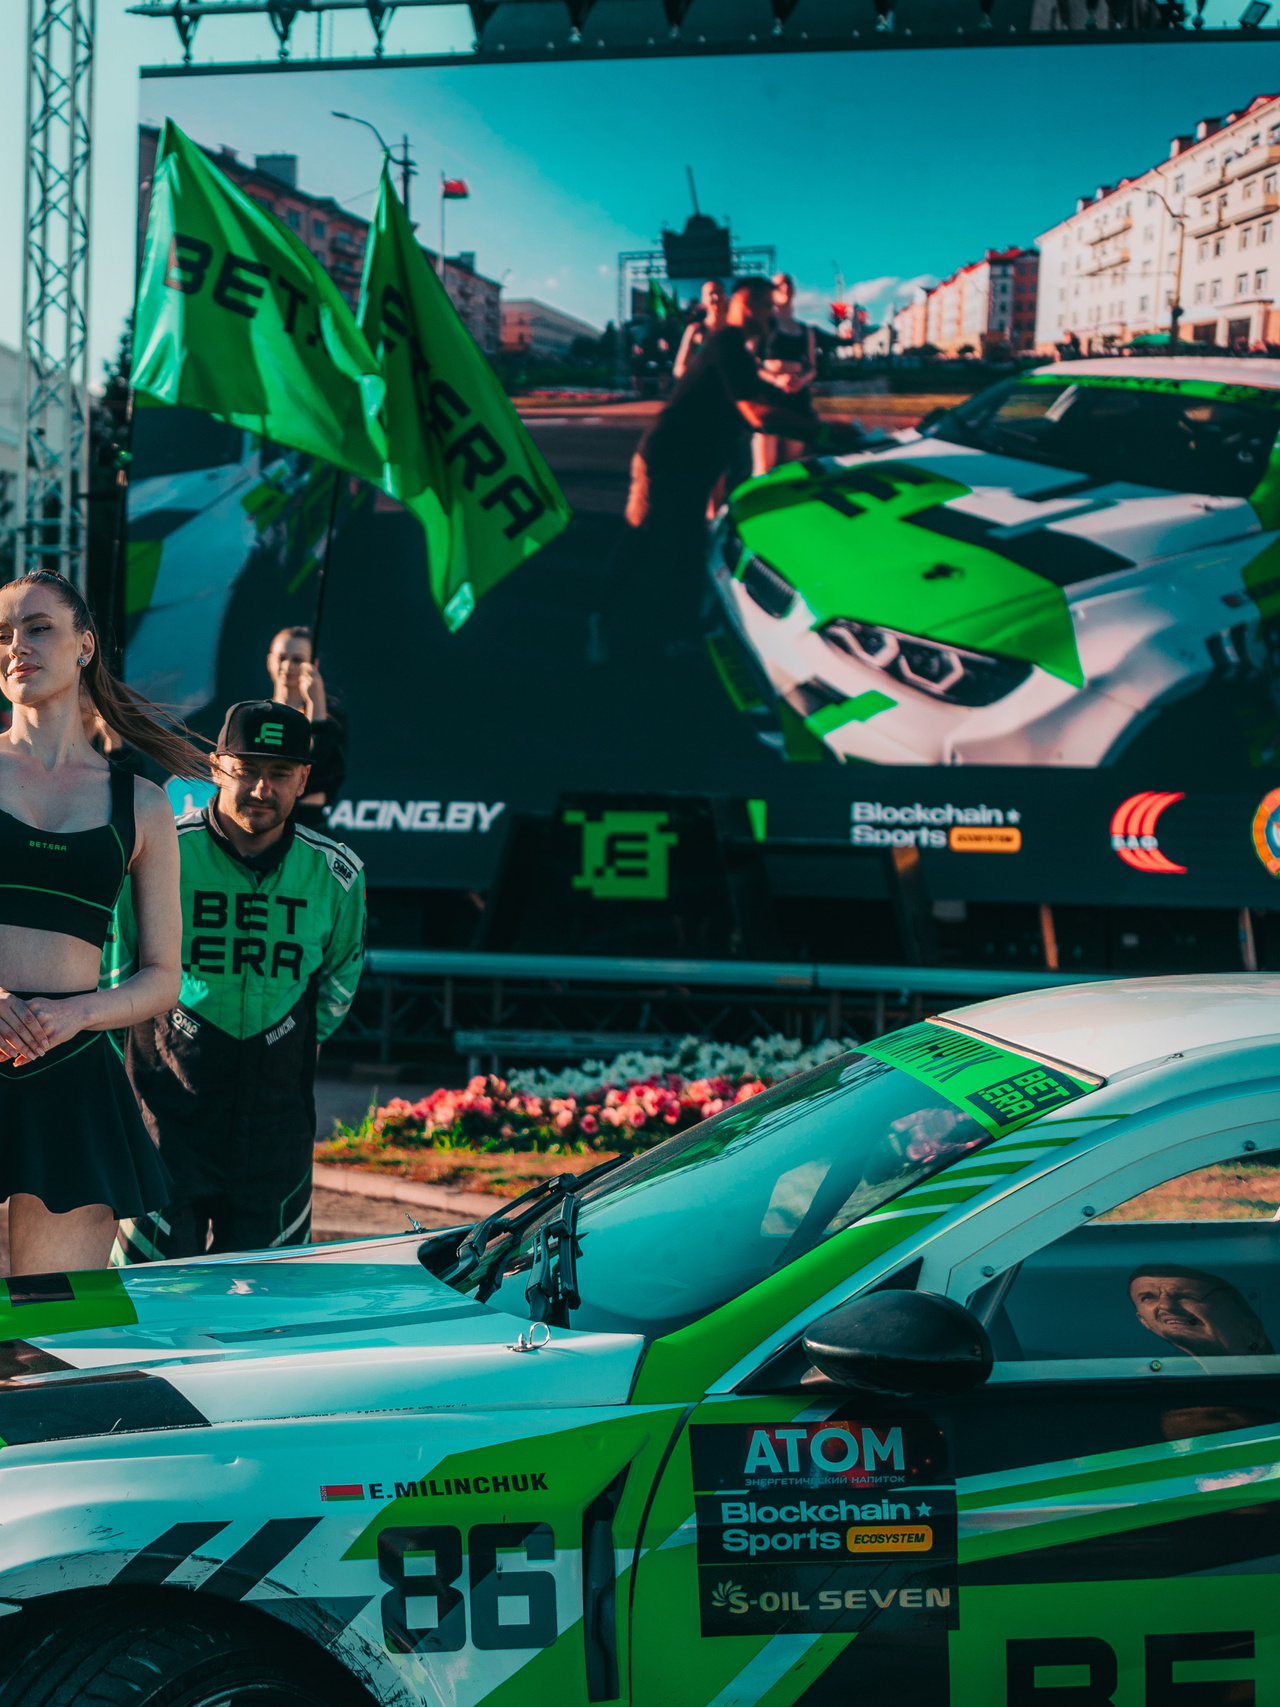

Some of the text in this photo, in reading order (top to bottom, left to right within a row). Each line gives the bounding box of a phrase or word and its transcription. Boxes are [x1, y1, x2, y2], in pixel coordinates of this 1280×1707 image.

[322, 800, 505, 832] ACING.BY
[850, 801, 1005, 826] Blockchain
[850, 825, 948, 848] Sports
[333, 860, 354, 880] OMP
[192, 889, 308, 935] BET
[173, 1012, 199, 1034] OMP
[265, 1015, 297, 1046] MILINCHUK
[368, 1472, 550, 1500] E.MILINCHUK
[744, 1475, 906, 1487] ЭНЕРГЕТИЧЕСКИЙ НАПИТОК
[721, 1498, 911, 1524] Blockchain
[722, 1527, 926, 1556] Sports ECOSYSTEM
[378, 1522, 557, 1654] 86
[728, 1587, 952, 1614] S-OIL SEVEN
